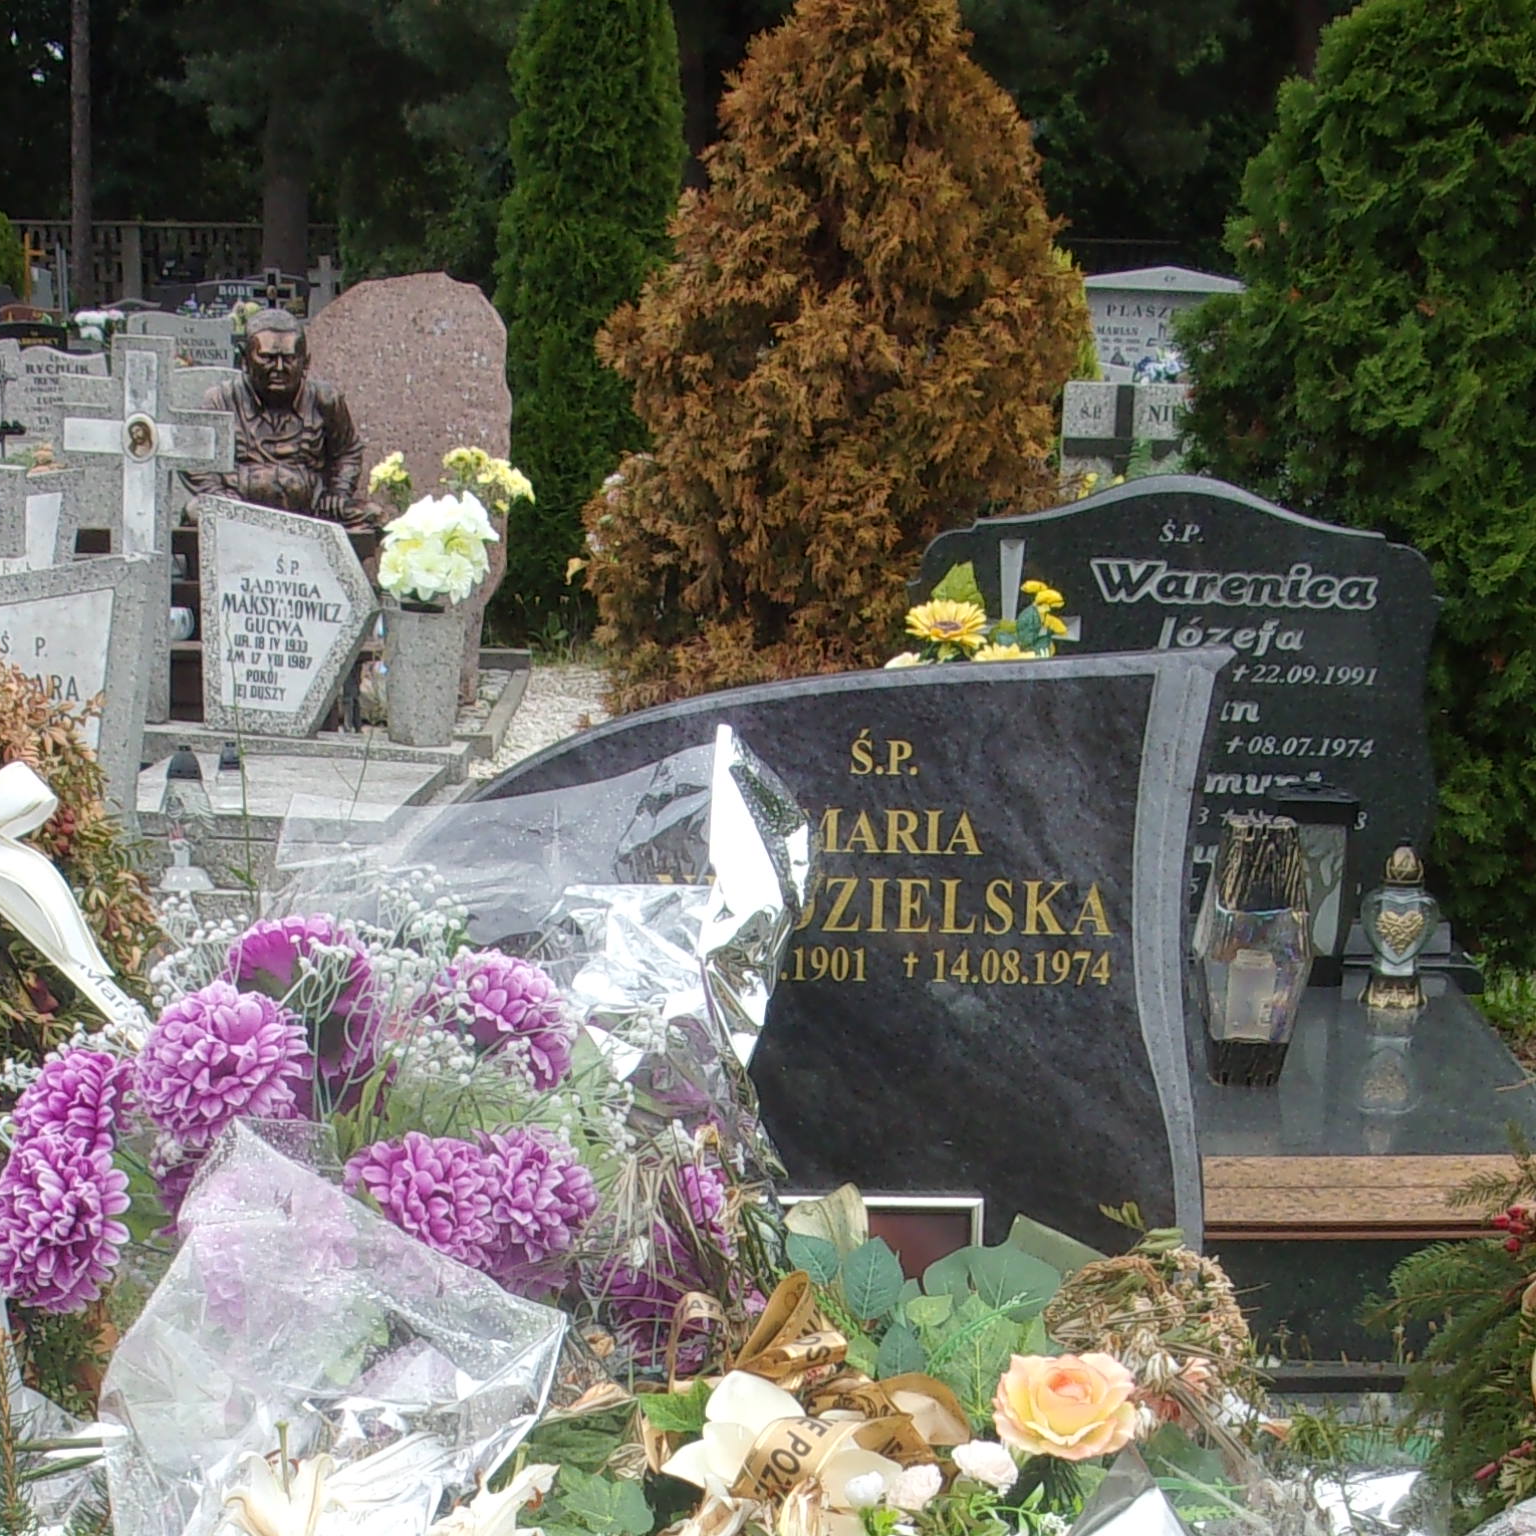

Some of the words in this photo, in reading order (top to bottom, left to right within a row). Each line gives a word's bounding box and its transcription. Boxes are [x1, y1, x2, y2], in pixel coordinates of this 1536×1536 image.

[240, 577, 322, 600] JADWIGA
[1090, 556, 1379, 610] Warenica
[244, 616, 304, 638] GUCWA
[287, 655, 313, 670] 1987
[250, 686, 287, 702] DUSZY
[930, 949, 1113, 986] 14.08.1974
